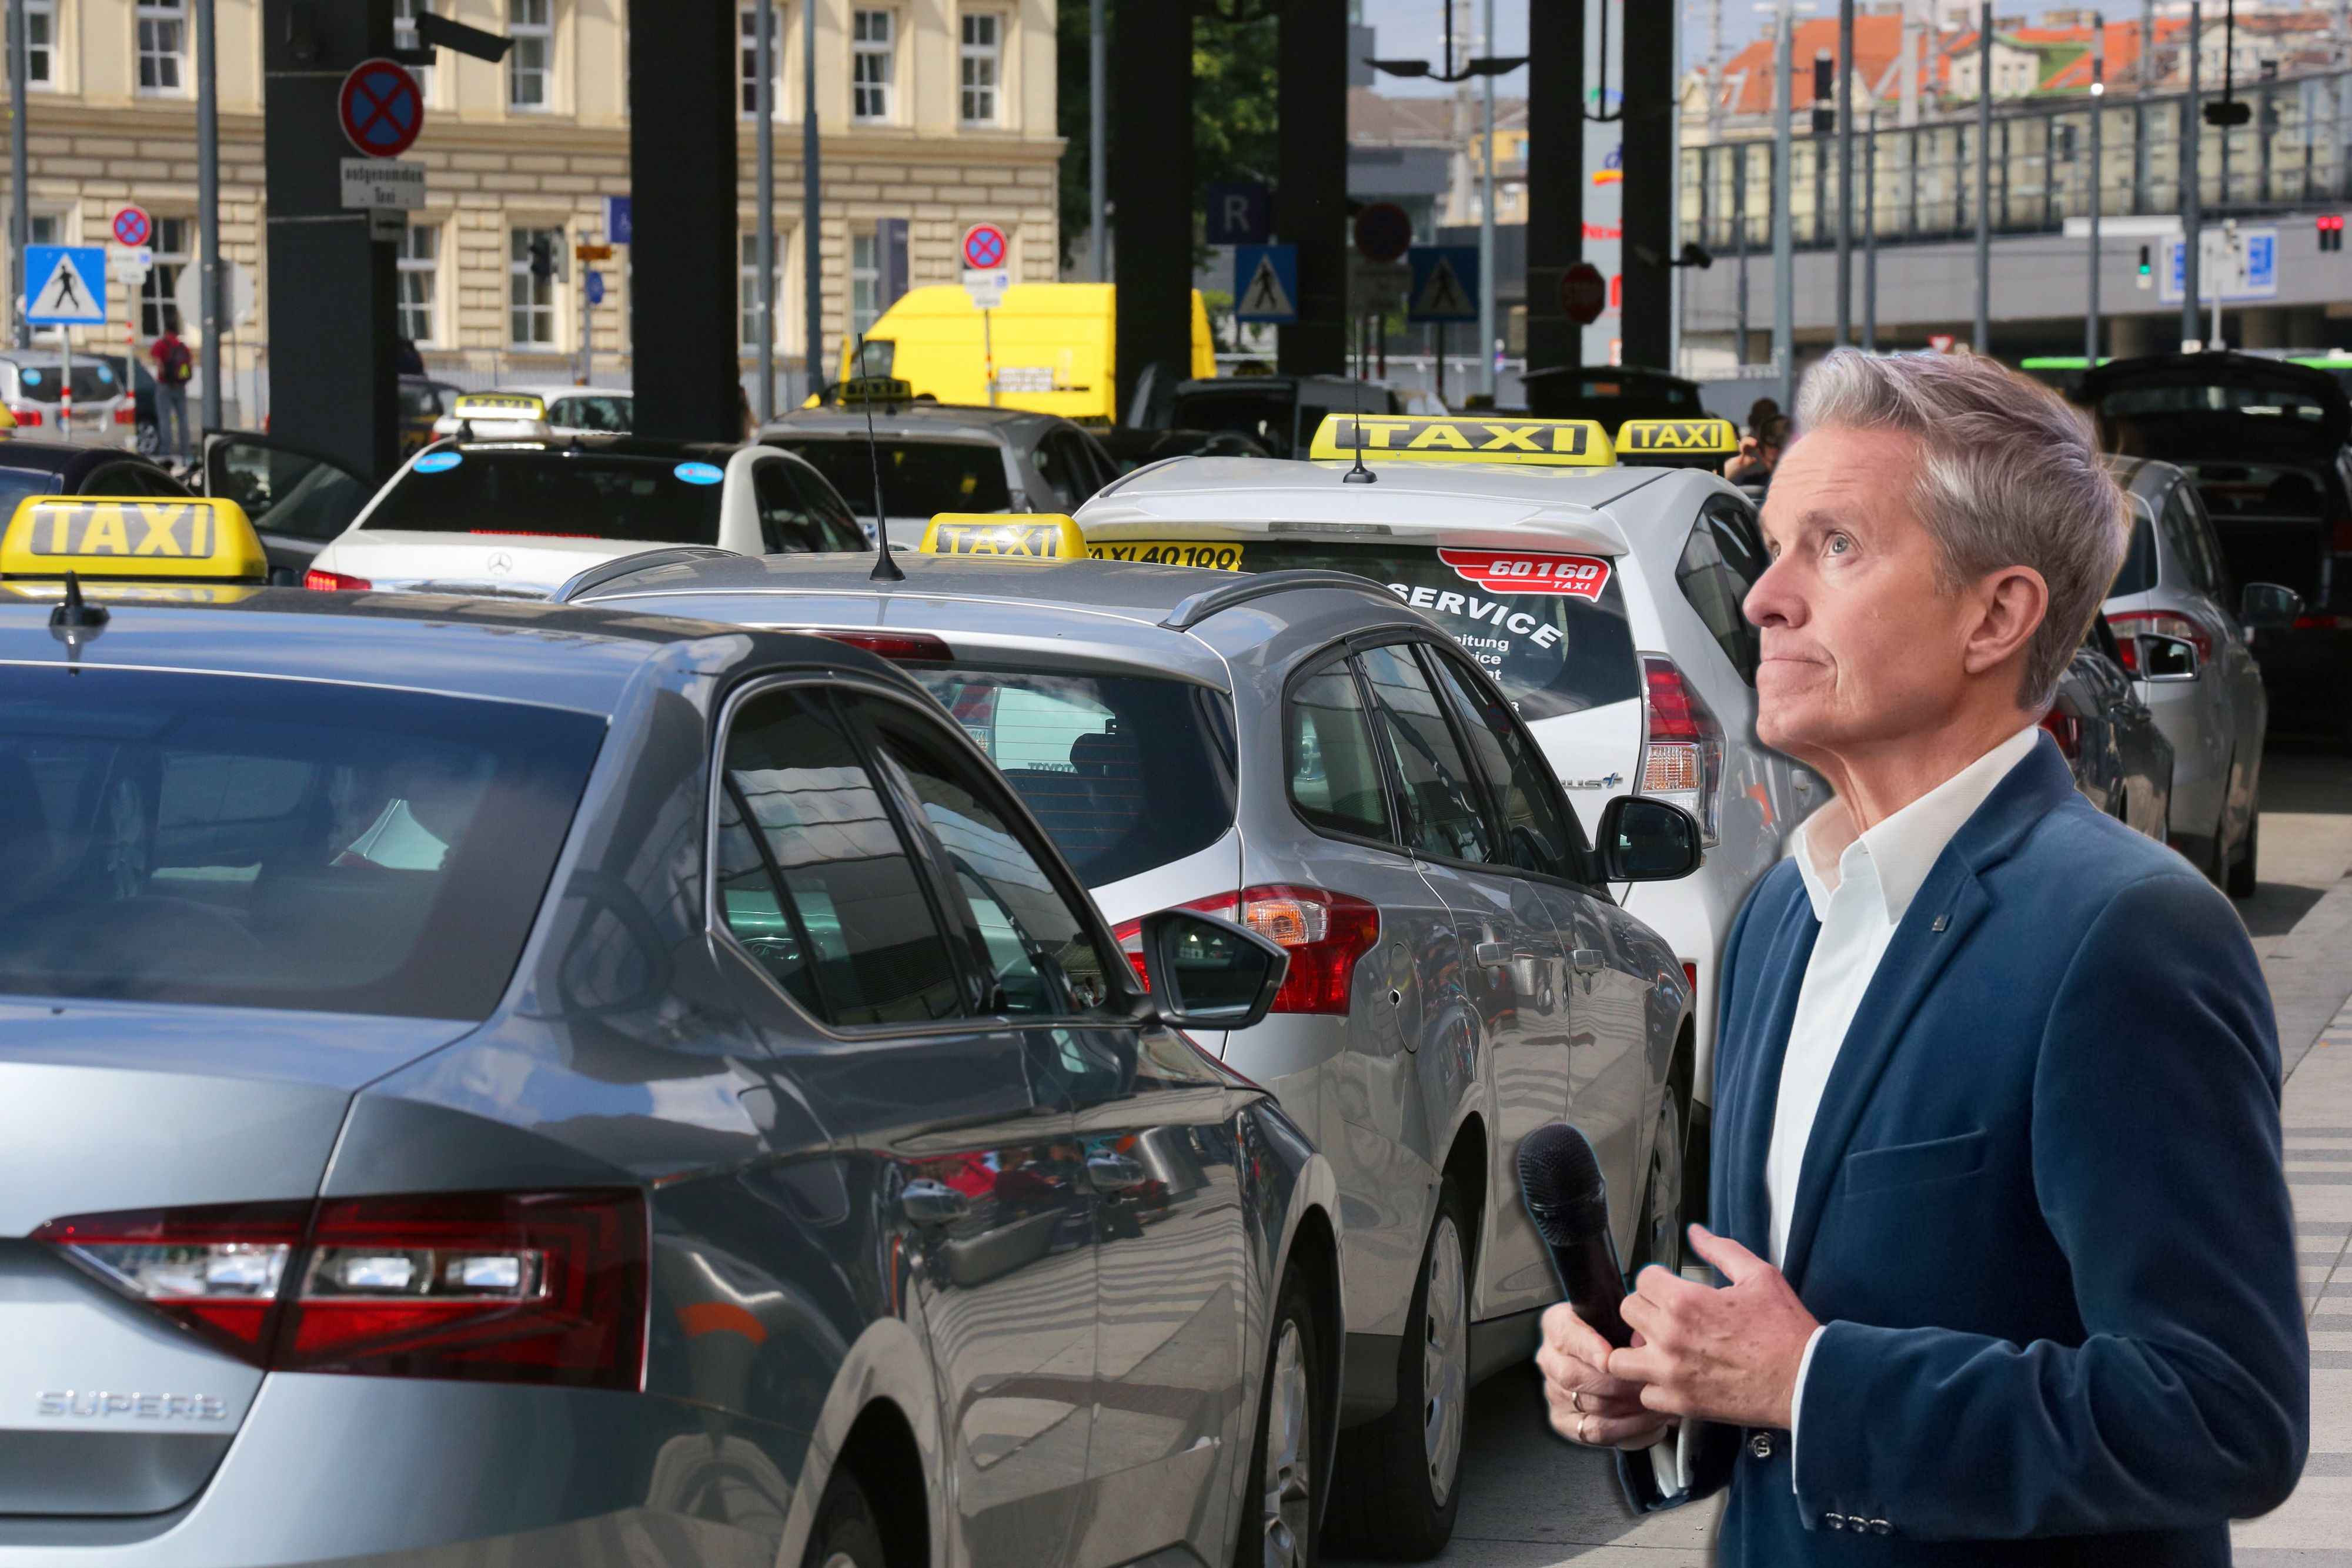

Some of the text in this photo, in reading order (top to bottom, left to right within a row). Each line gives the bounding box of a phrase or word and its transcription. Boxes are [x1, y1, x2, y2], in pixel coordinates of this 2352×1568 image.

[1224, 195, 1250, 232] R
[1352, 422, 1574, 452] TAXI
[1635, 424, 1718, 447] TAXI
[43, 502, 209, 556] TAXI
[943, 527, 1052, 557] TAXI
[1489, 561, 1599, 580] 60160
[1553, 581, 1590, 590] TAXI
[1386, 583, 1564, 649] SERVICE
[35, 1390, 229, 1420] SUPERB
